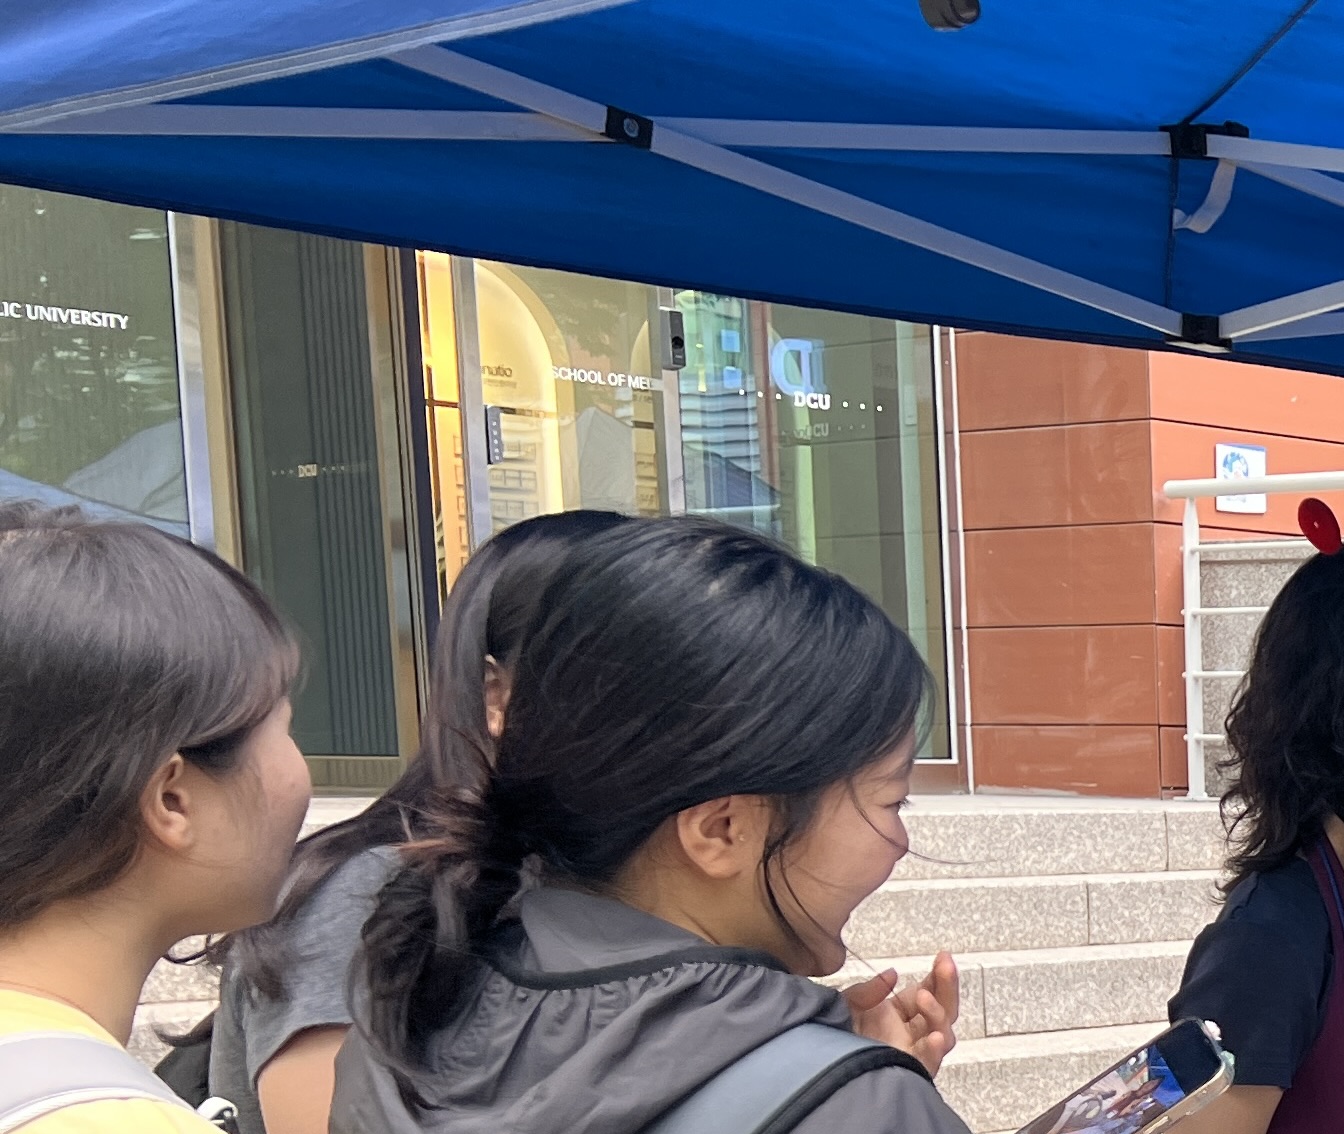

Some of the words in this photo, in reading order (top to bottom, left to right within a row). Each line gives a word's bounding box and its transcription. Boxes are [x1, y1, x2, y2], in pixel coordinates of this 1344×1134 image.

[25, 303, 129, 330] UNIVERSITY
[552, 365, 607, 386] SCHOOL
[608, 372, 627, 387] OF
[794, 390, 831, 411] DCU
